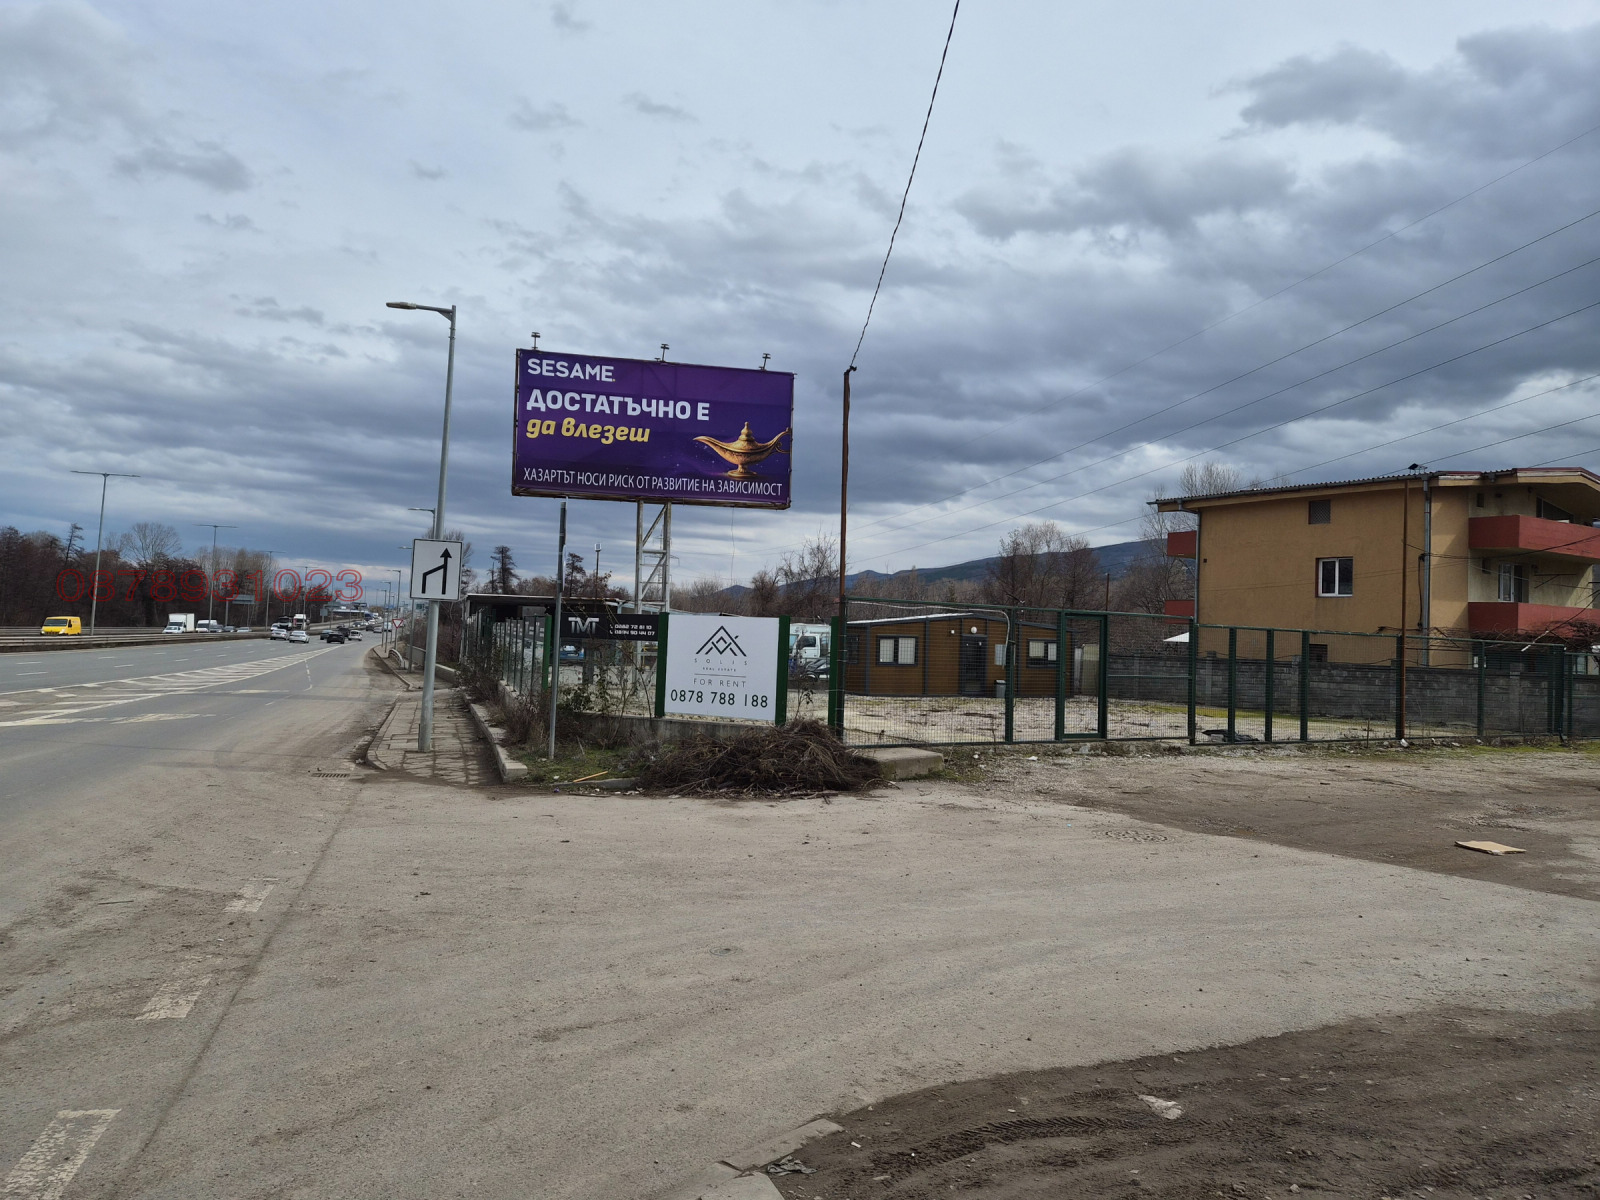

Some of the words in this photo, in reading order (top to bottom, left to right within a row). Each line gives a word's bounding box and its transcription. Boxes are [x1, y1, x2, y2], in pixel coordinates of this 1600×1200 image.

[526, 388, 692, 420] ДОСТАТЪЧНО
[697, 402, 710, 421] Е
[526, 418, 556, 439] да
[561, 417, 650, 445] влезеш
[523, 467, 575, 485] ХАЗАРТЪТ
[577, 471, 607, 486] НОСИ
[608, 473, 634, 488] РИСК
[636, 475, 651, 489] ОТ
[652, 476, 700, 492] РАЗВИТИЕ
[702, 479, 715, 492] НА
[717, 480, 783, 497] ЗАВИСИМОСТ
[568, 616, 599, 634] TMT
[694, 658, 747, 666] SOLIS
[693, 678, 713, 686] FOR
[719, 680, 747, 688] RENT
[670, 689, 703, 703] 0878
[710, 691, 735, 705] 788
[744, 694, 768, 708] 188
